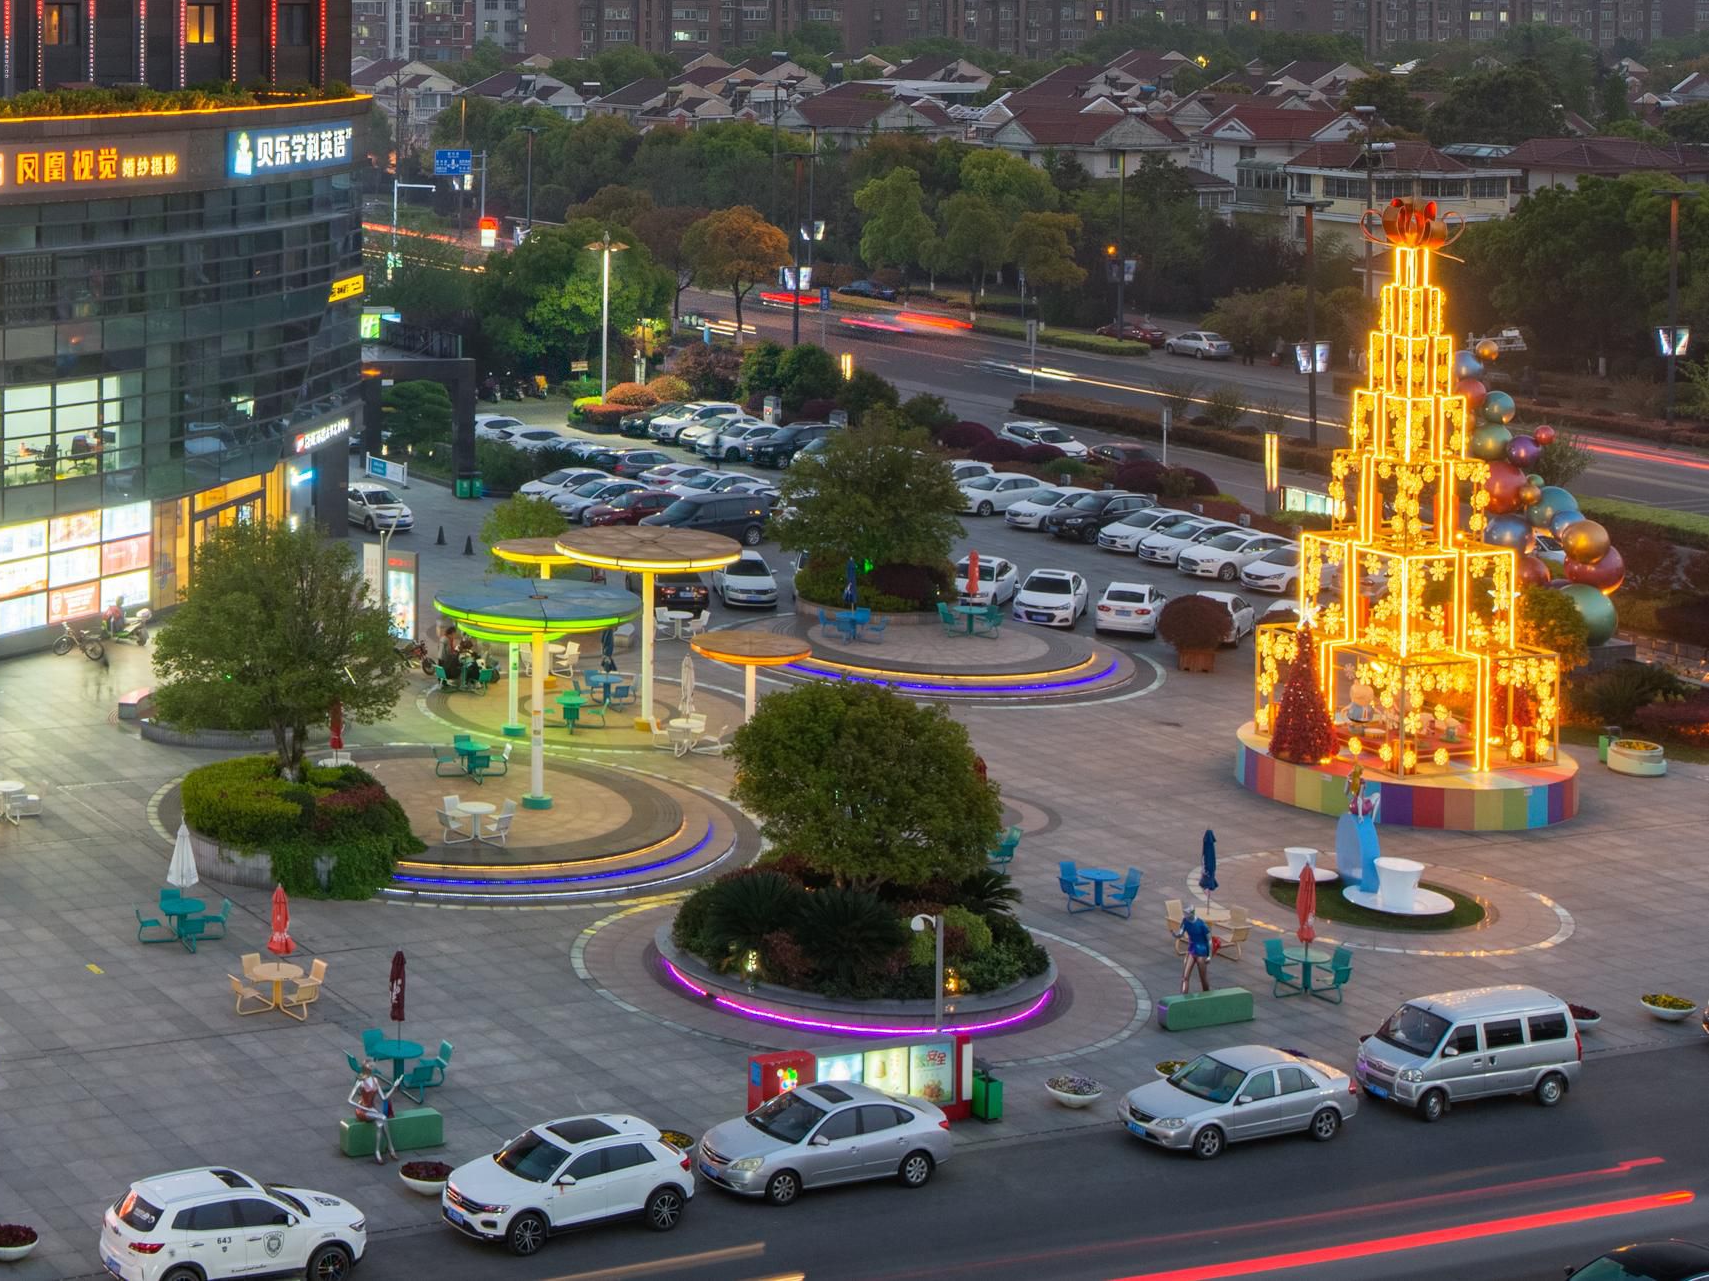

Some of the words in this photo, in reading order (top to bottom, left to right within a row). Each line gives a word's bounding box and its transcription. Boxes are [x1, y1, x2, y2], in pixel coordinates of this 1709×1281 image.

[16, 148, 119, 185] 凤凰视觉
[121, 154, 179, 179] 婚纱摄影
[256, 129, 347, 168] 贝乐学科英语
[216, 1236, 233, 1245] 643
